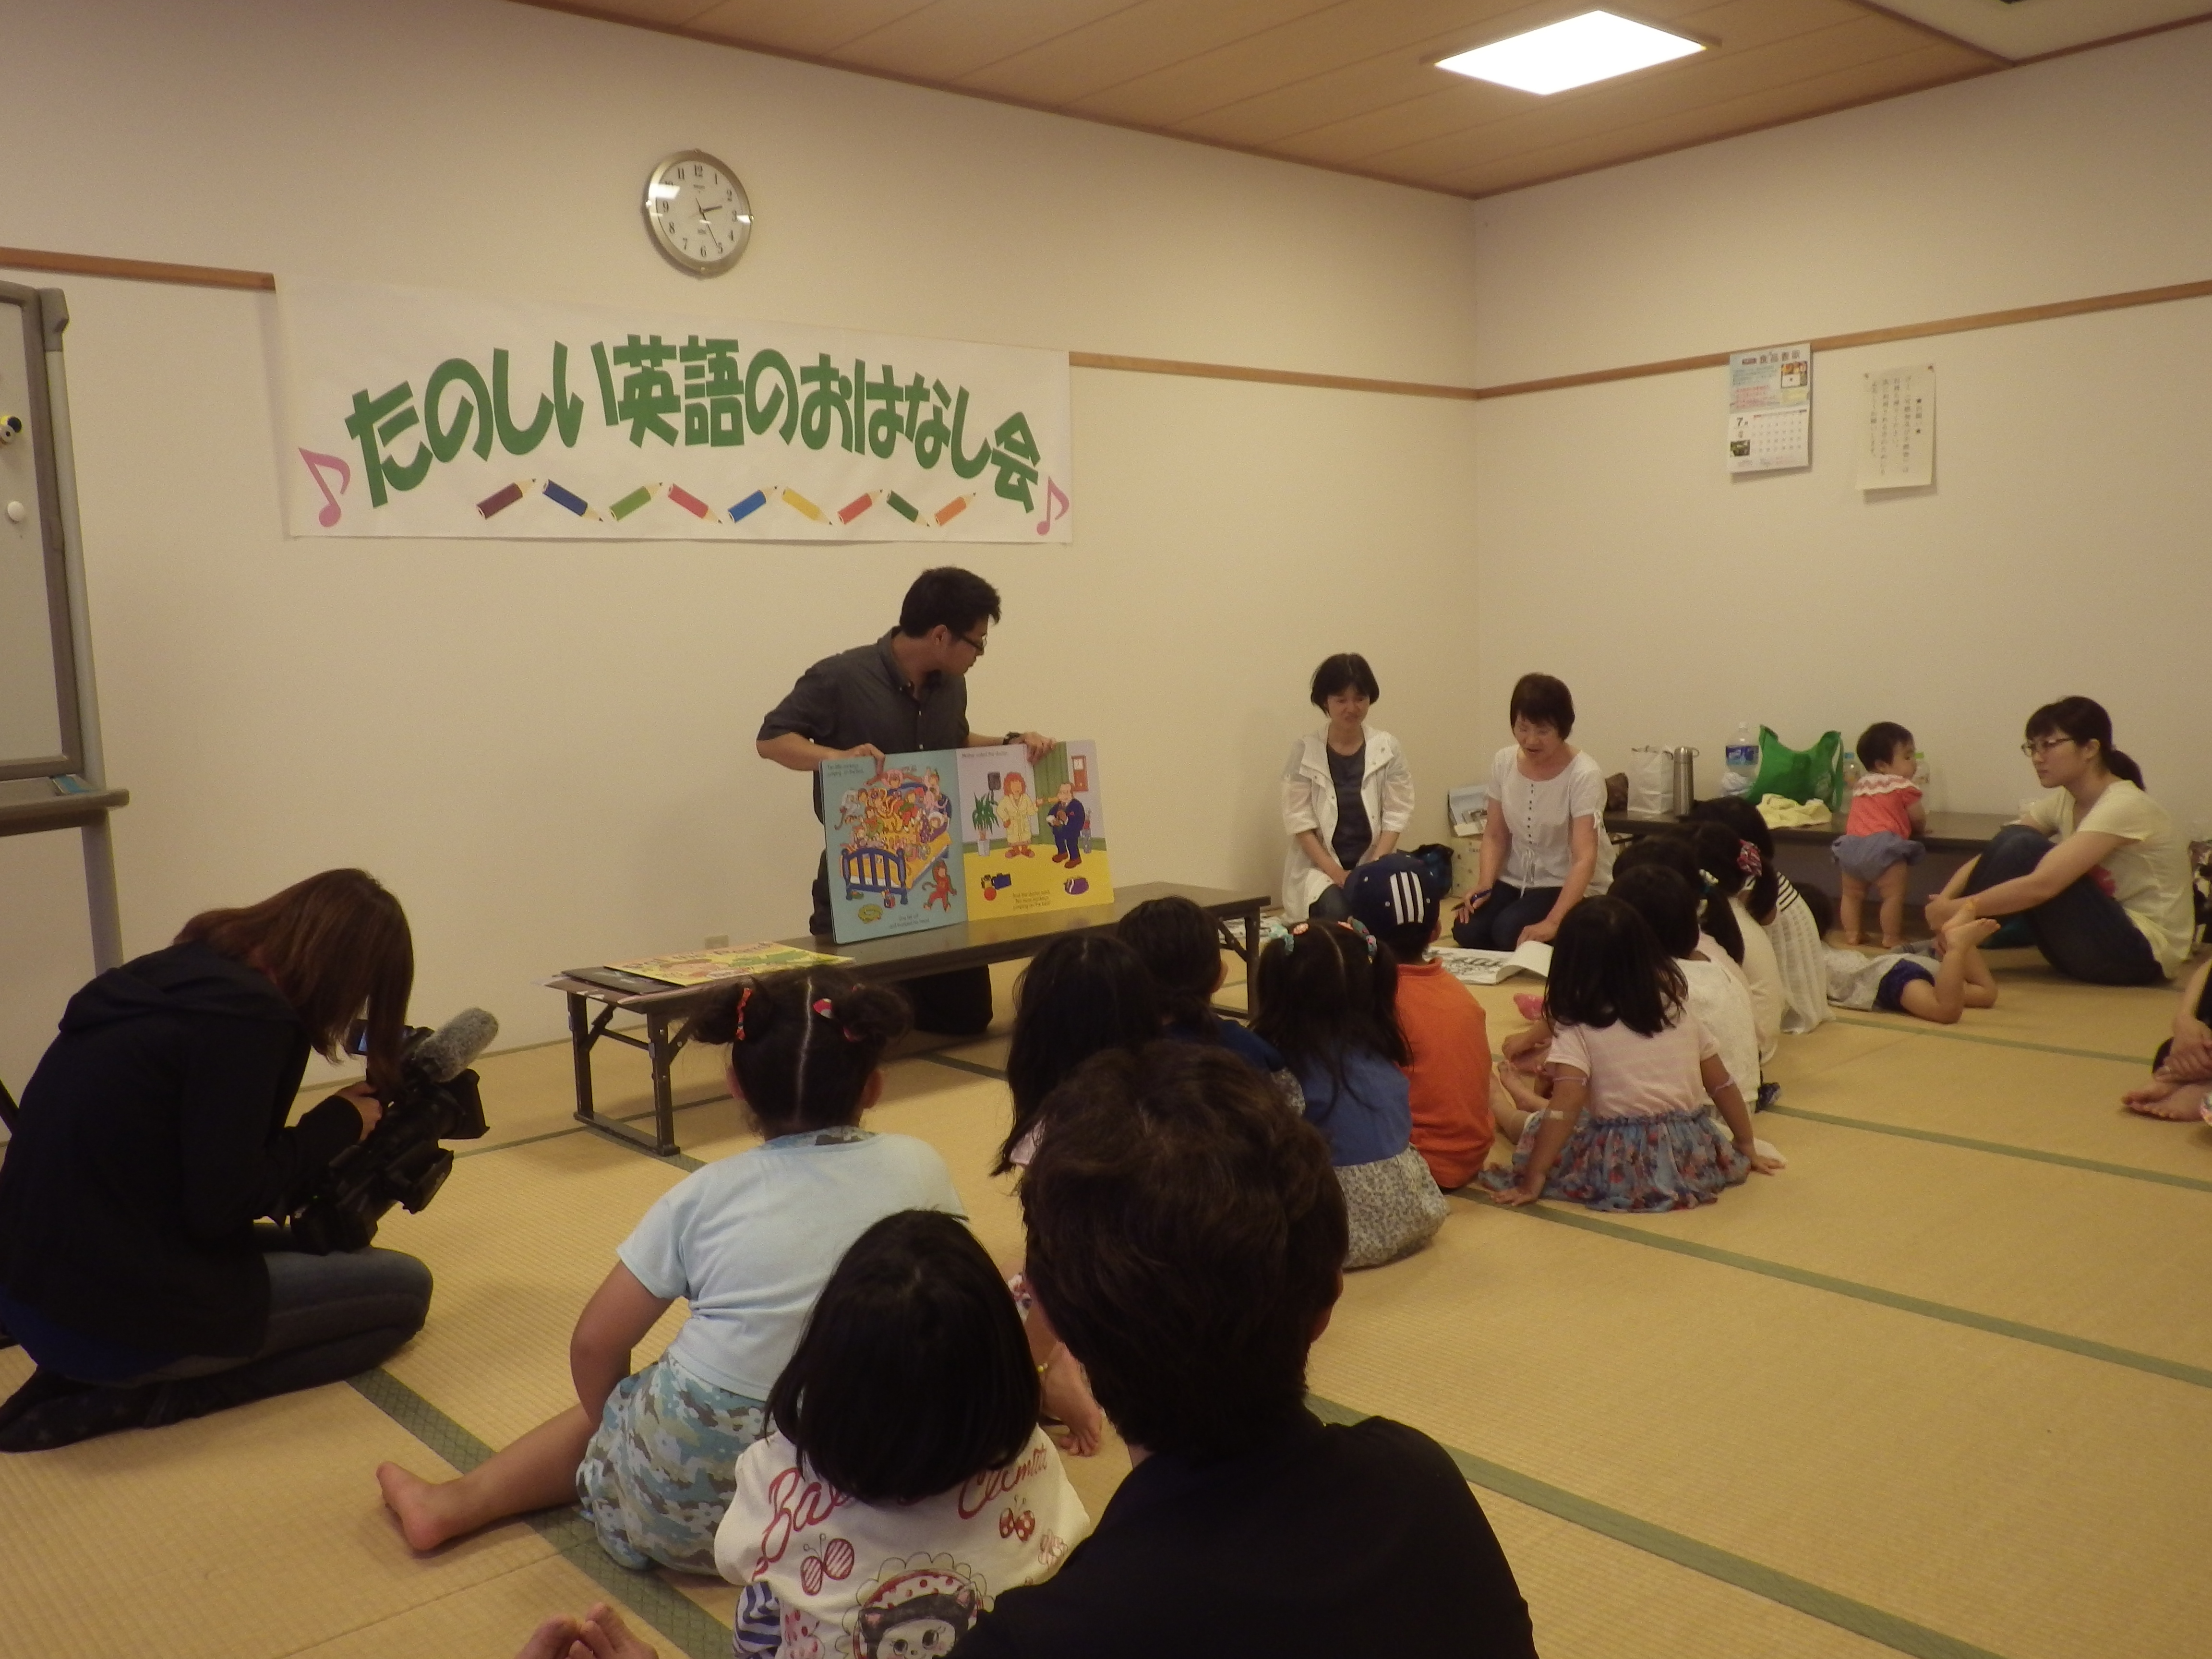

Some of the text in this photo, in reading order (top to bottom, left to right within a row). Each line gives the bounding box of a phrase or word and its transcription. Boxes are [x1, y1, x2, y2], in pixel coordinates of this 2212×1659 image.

[677, 168, 685, 180] 11
[694, 165, 703, 177] 12
[715, 173, 718, 185] 1
[727, 189, 733, 202] 2
[663, 200, 669, 213] 9
[669, 221, 675, 234] 8
[728, 229, 734, 242] 4
[683, 238, 688, 250] 7
[700, 246, 706, 257] 6
[345, 335, 1042, 513] たのしい英語のおはなし会
